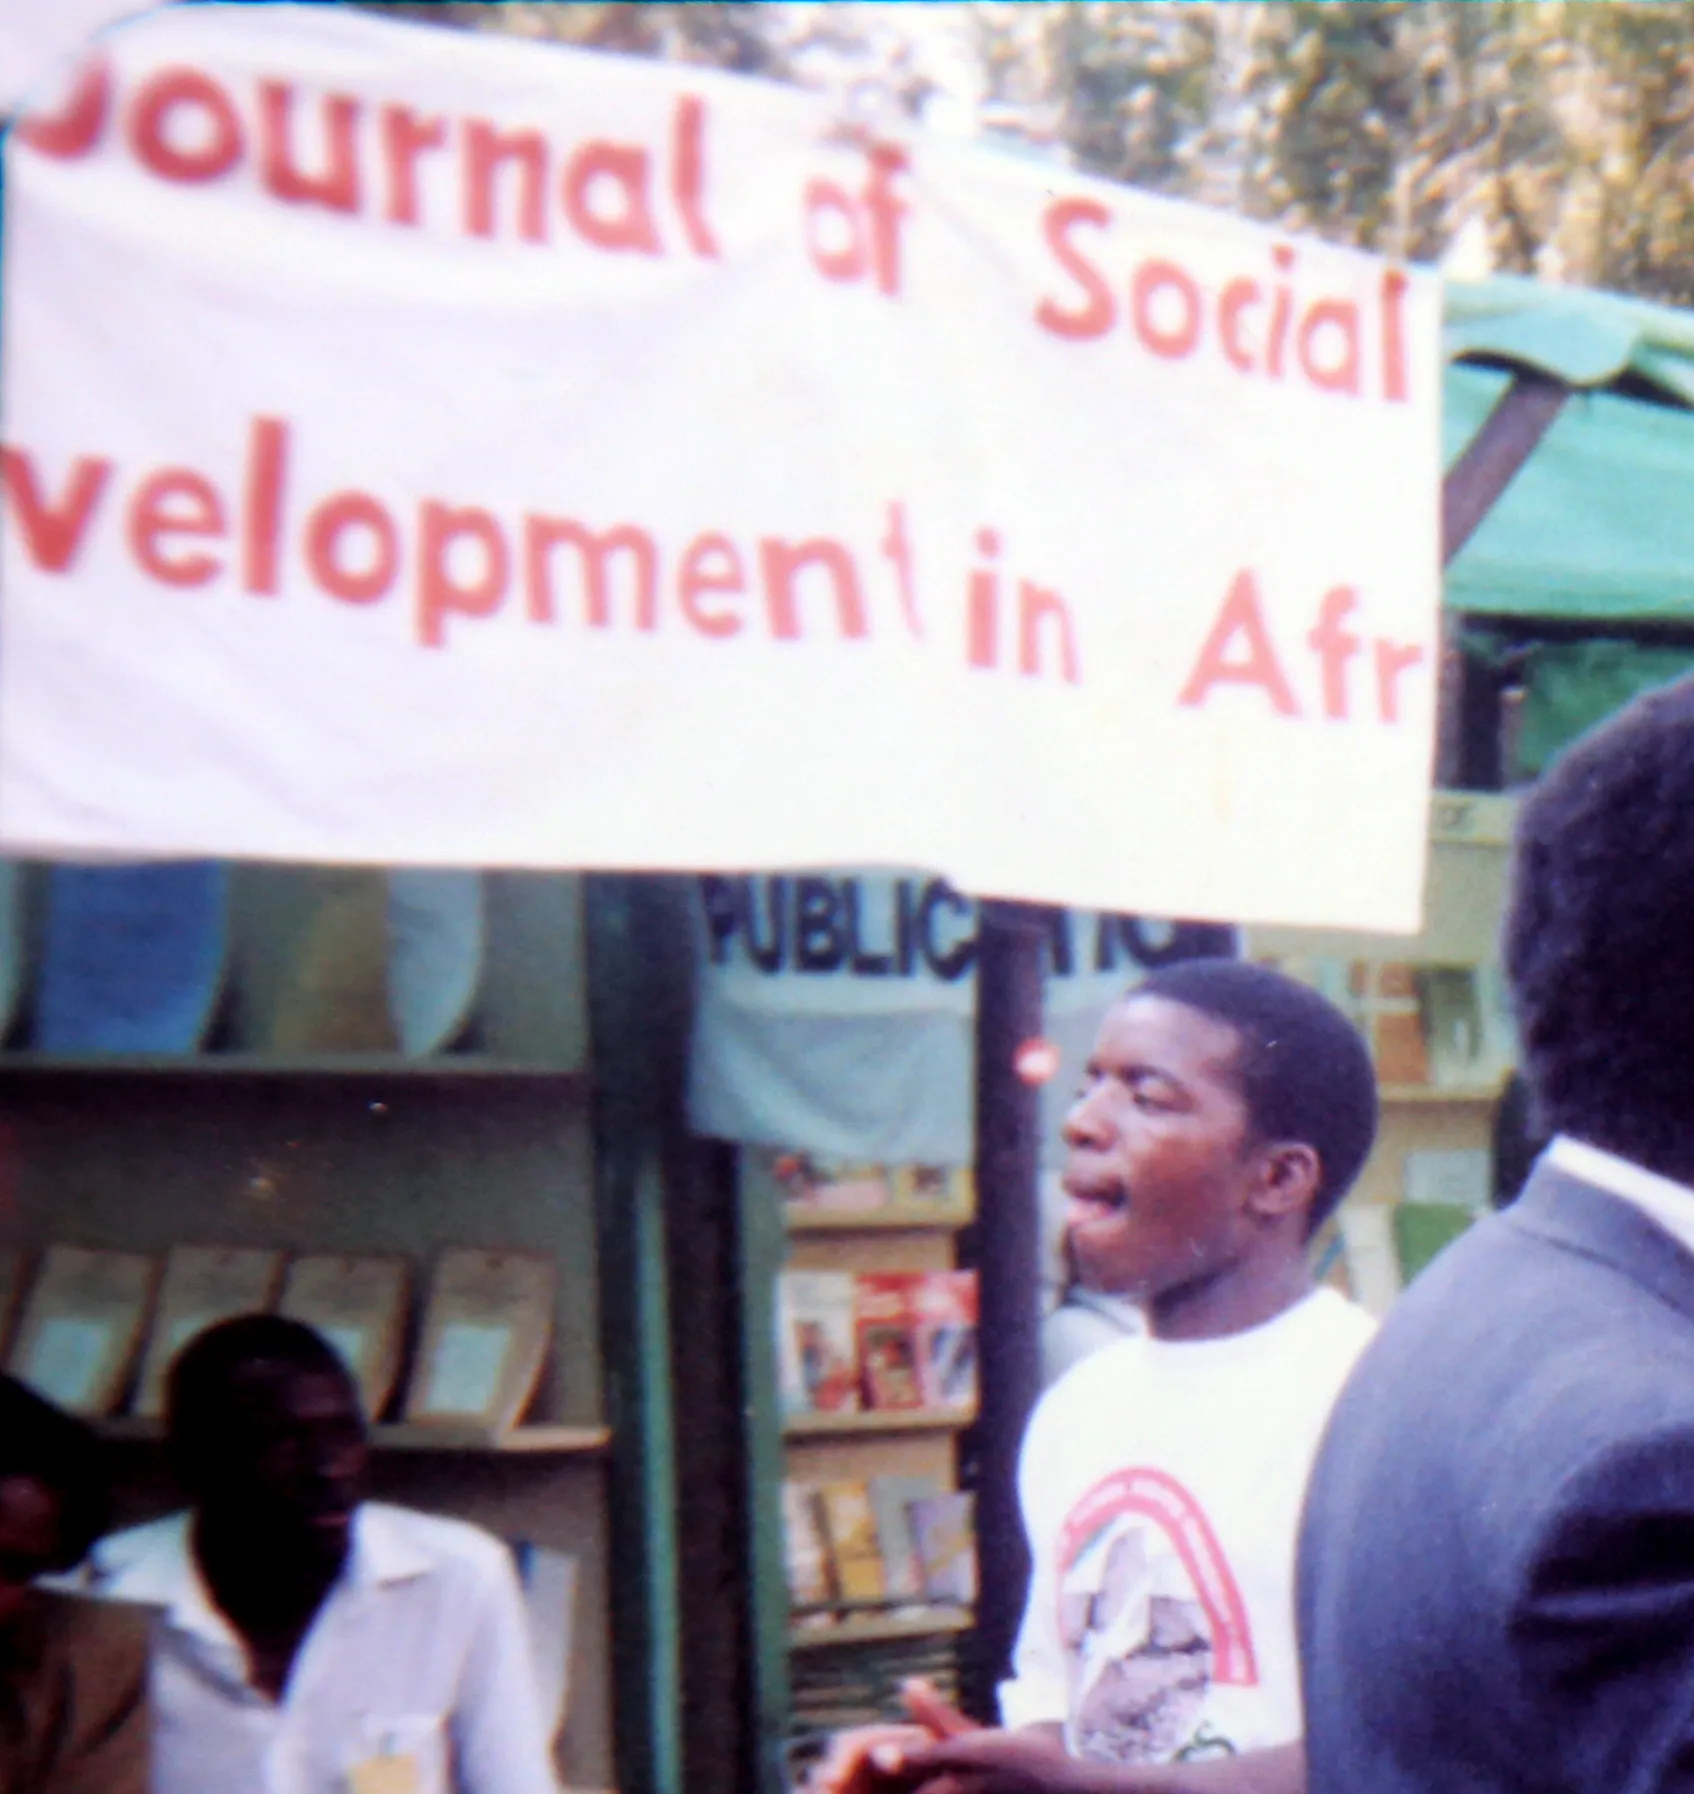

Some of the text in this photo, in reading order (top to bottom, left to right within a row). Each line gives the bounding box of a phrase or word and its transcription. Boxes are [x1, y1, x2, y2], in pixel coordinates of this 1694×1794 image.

[12, 50, 1409, 403] Journal of Social
[0, 415, 925, 649] velopment
[967, 525, 1082, 687] in
